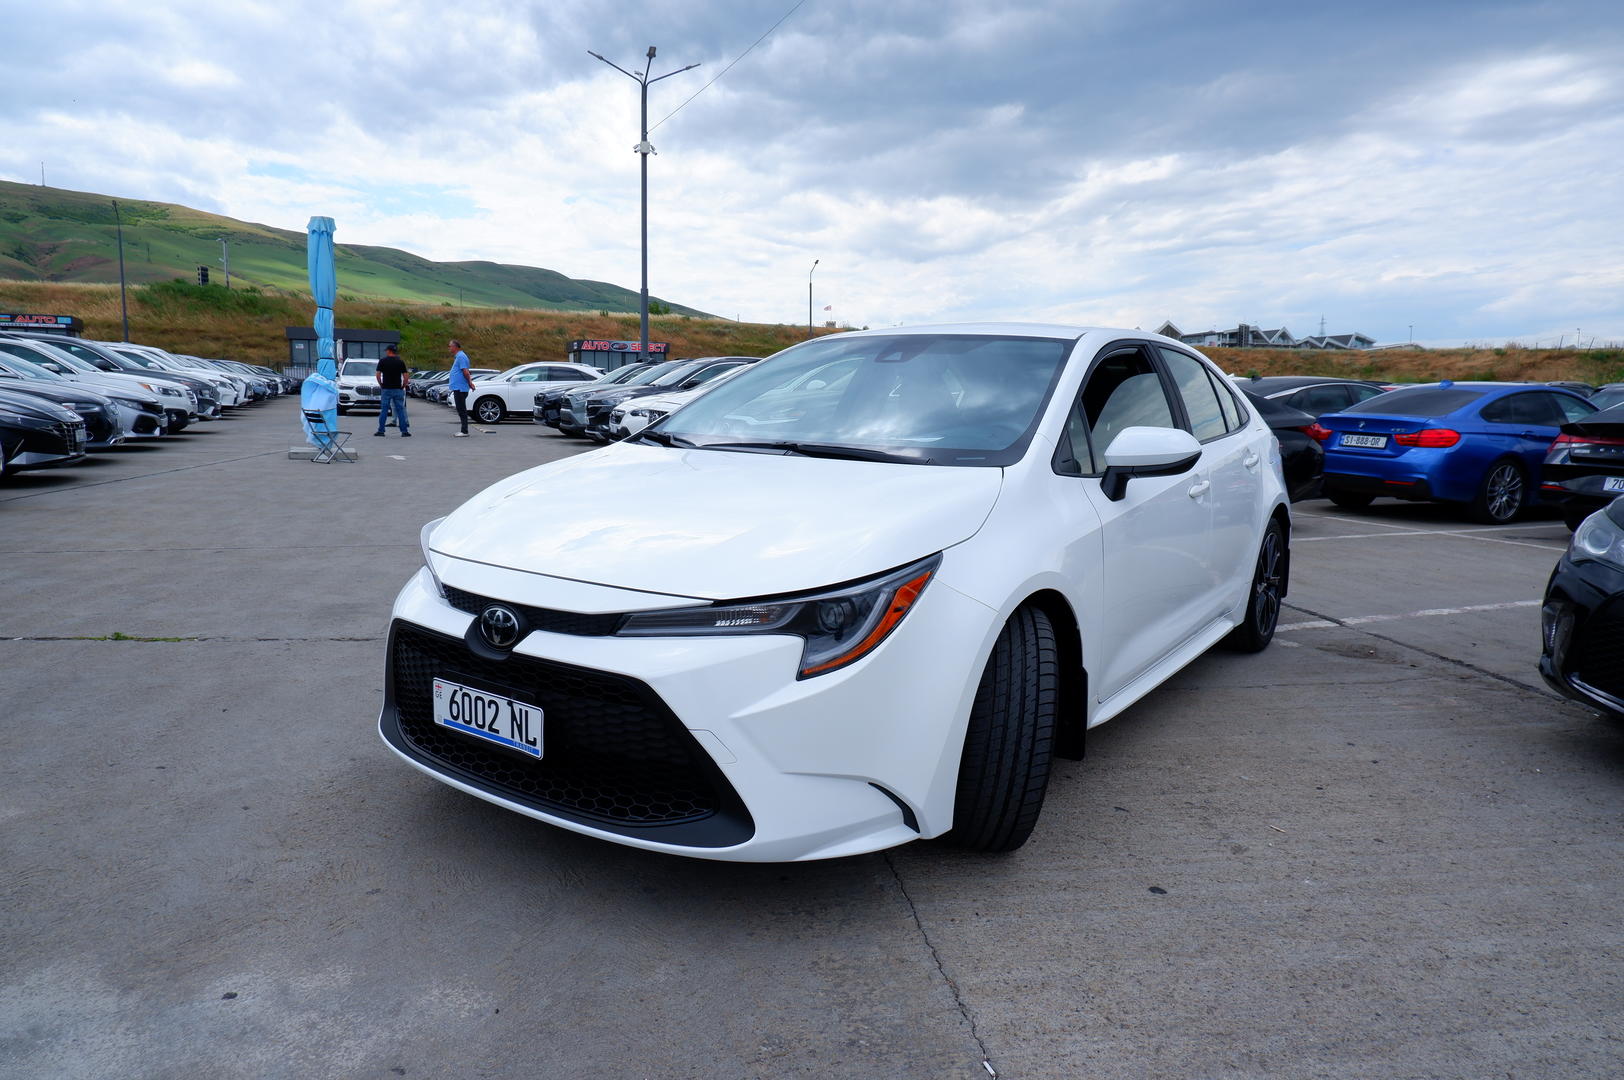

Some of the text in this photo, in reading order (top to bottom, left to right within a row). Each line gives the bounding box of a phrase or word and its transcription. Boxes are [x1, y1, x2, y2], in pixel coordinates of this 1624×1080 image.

[15, 315, 56, 324] AUTO
[581, 340, 609, 350] AUTO
[630, 343, 666, 352] SEECT
[449, 689, 537, 747] 6002 NL
